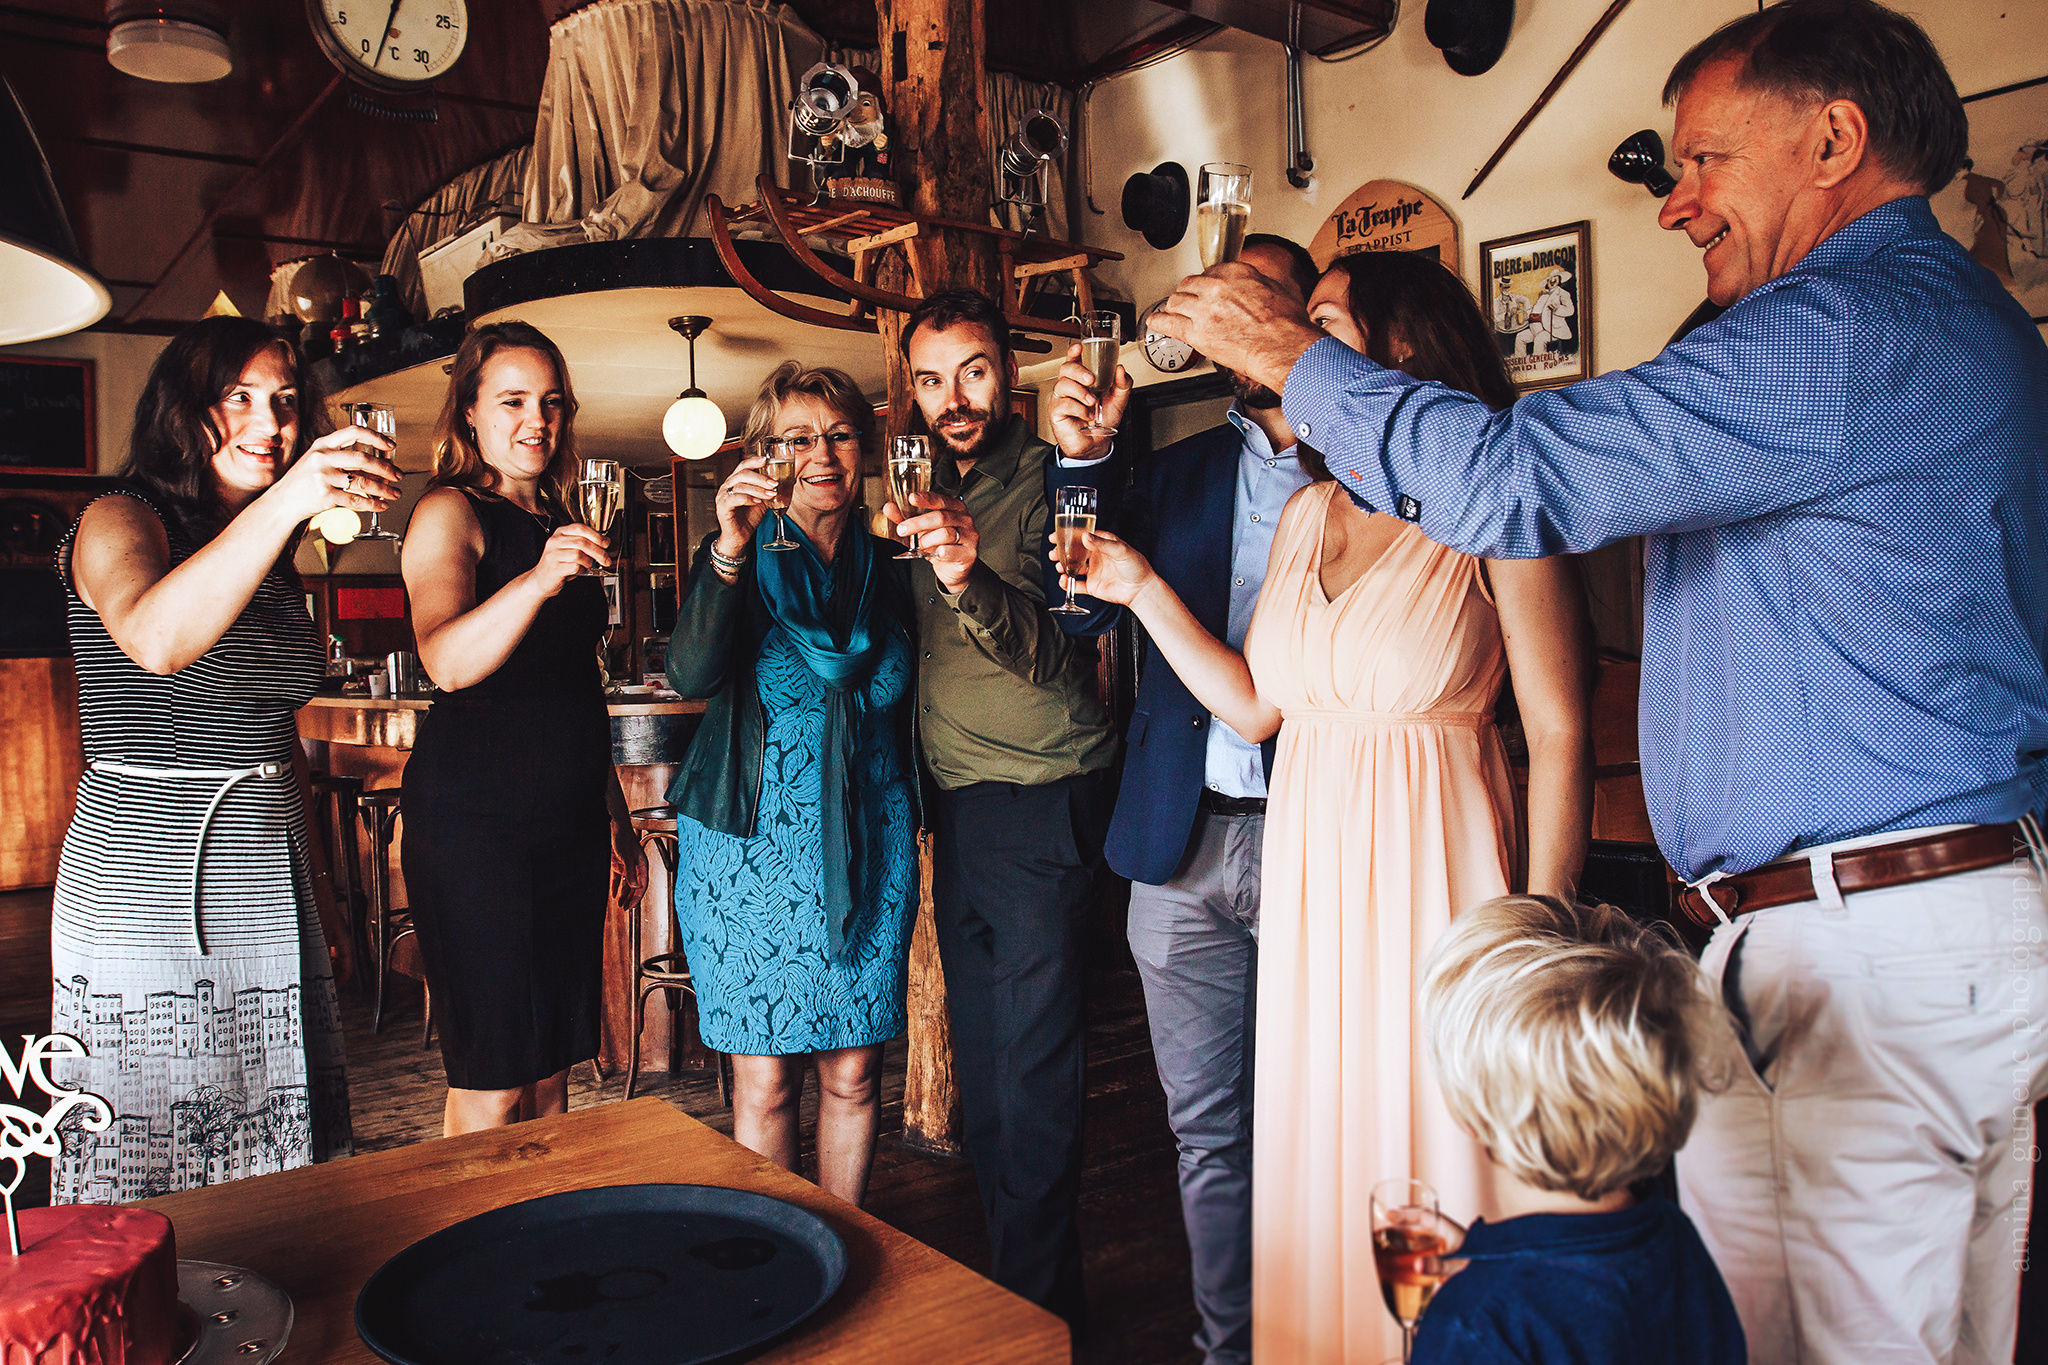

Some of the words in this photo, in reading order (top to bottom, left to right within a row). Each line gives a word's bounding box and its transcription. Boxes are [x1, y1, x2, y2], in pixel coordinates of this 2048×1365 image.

[338, 11, 347, 25] 5
[435, 14, 451, 30] 25
[361, 38, 370, 53] 0
[413, 48, 430, 64] 30
[1331, 210, 1357, 247] La
[1355, 198, 1424, 238] Trappe
[1345, 230, 1412, 255] TRAPPIST
[1532, 244, 1576, 271] DRAGON
[1168, 359, 1176, 369] 6
